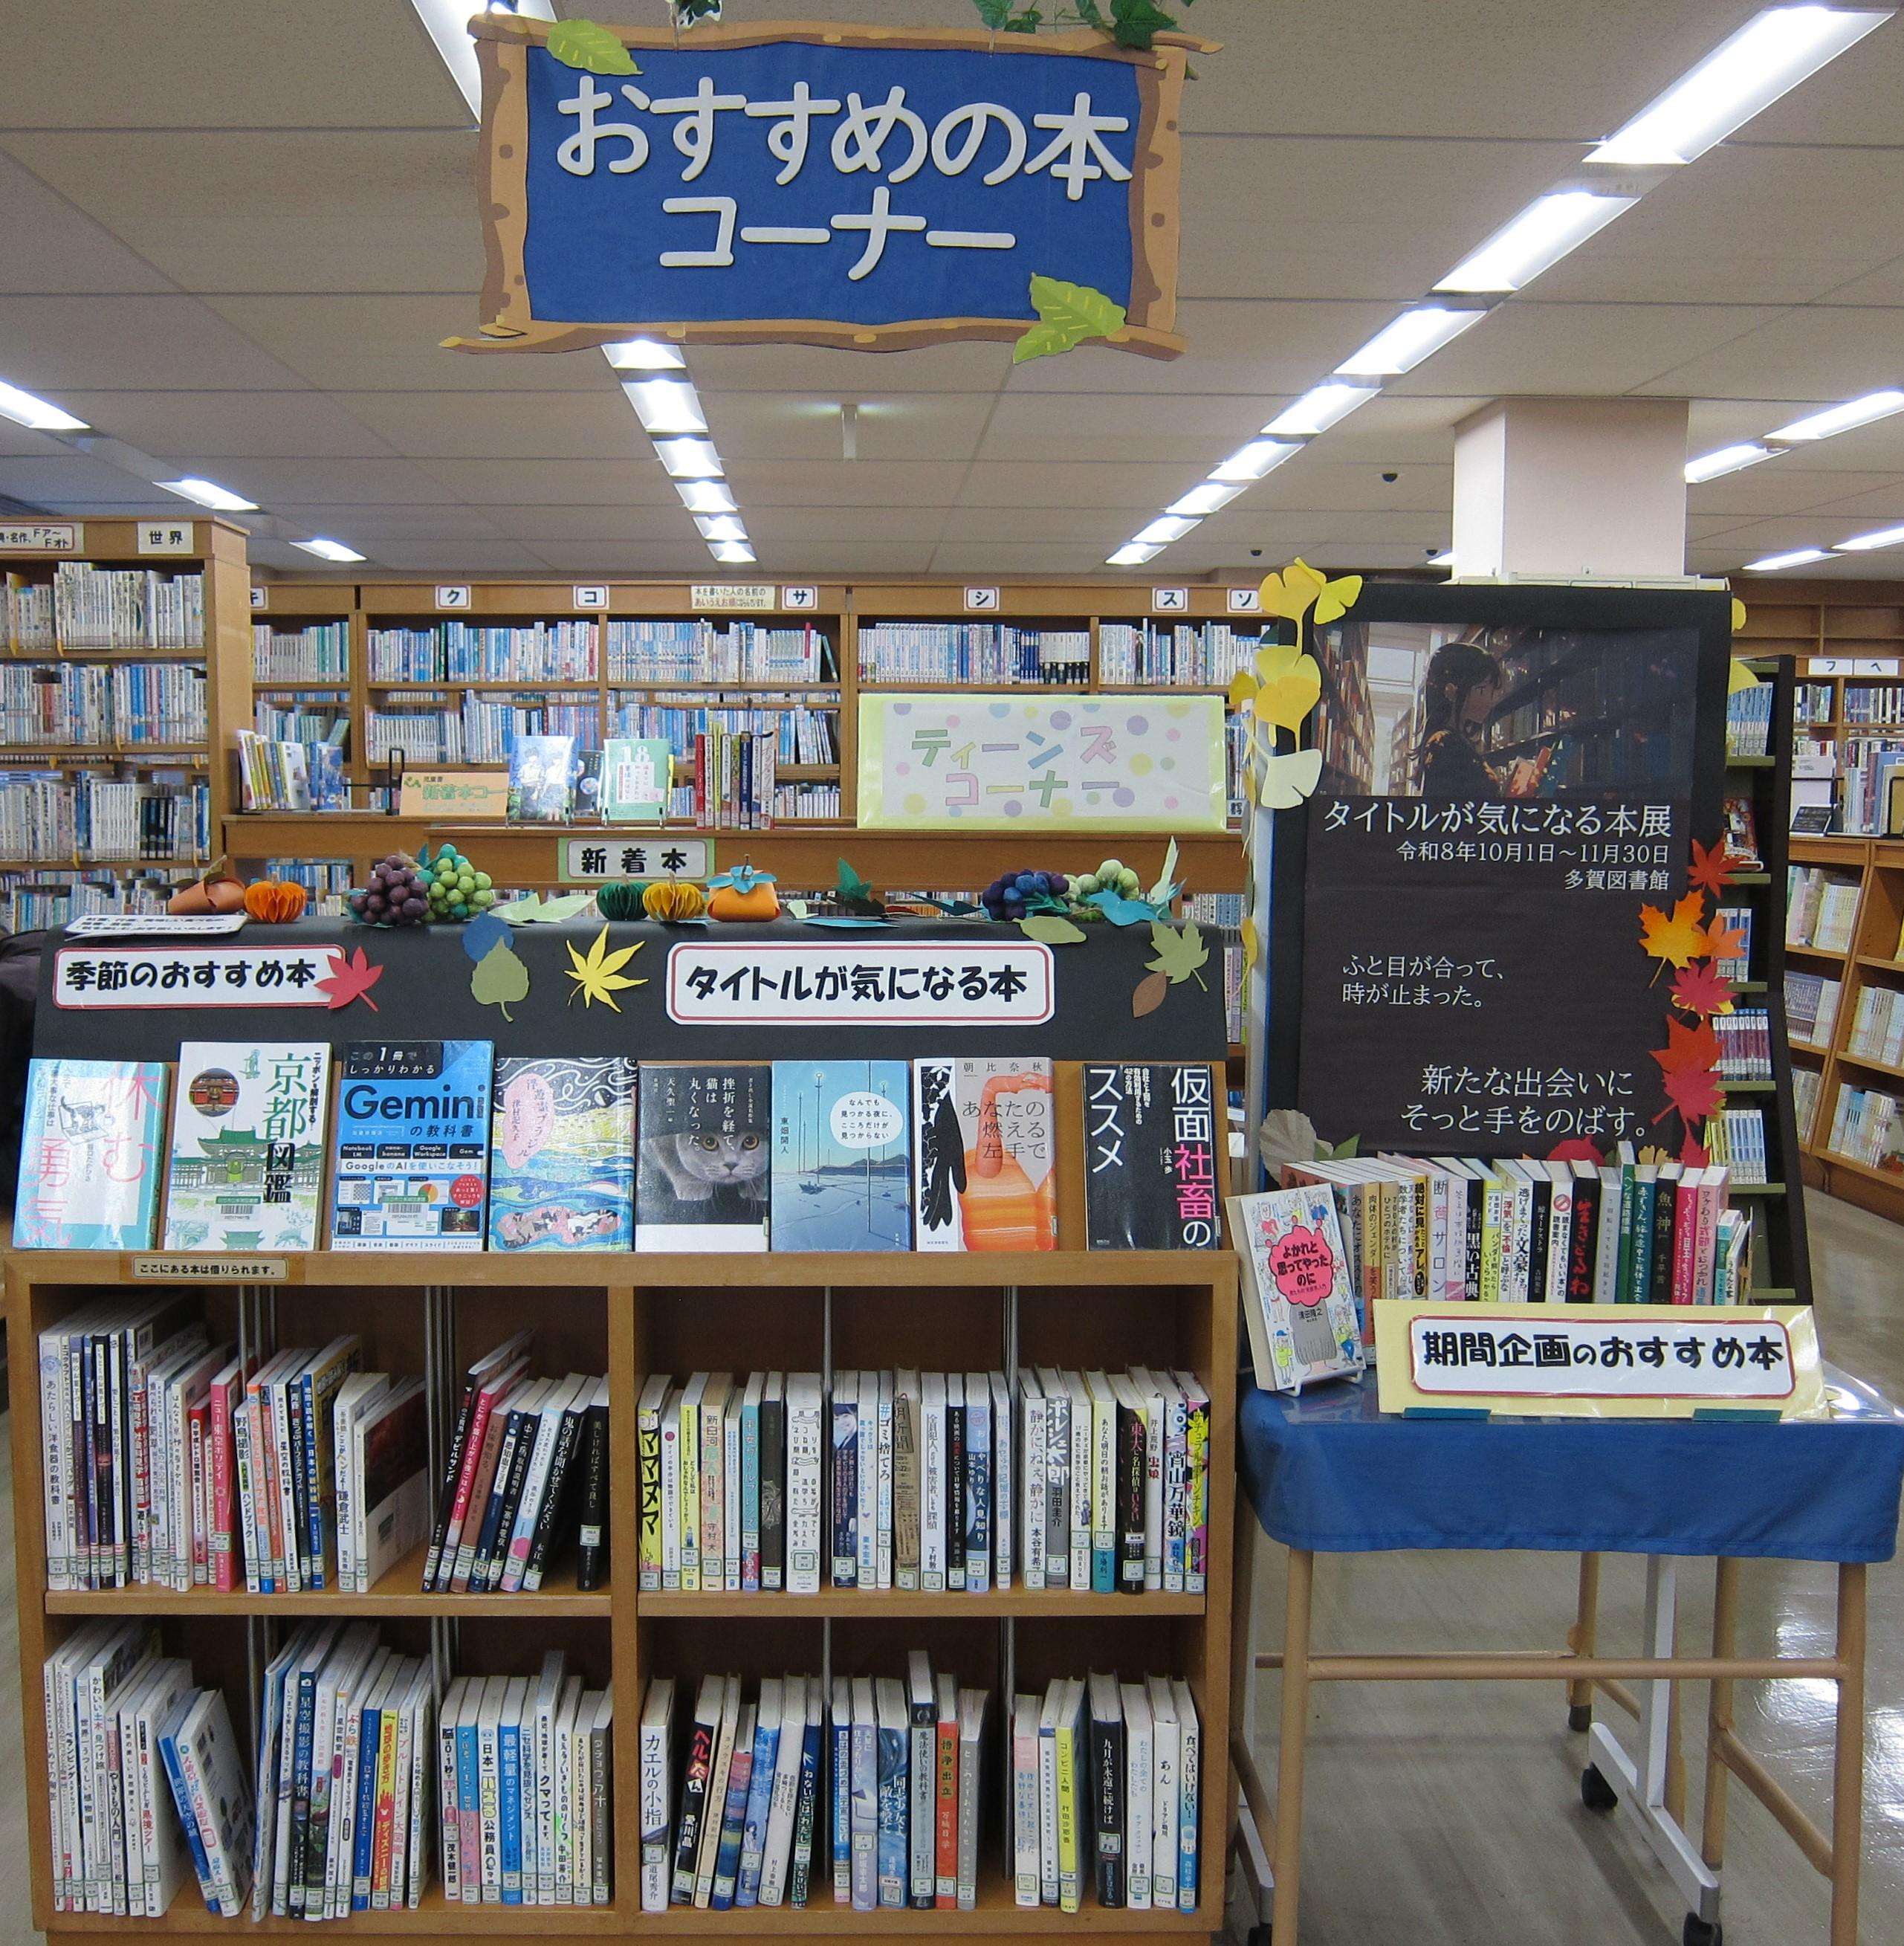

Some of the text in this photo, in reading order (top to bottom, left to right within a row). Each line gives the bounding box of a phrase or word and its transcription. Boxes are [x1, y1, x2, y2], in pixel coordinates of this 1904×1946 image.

[556, 75, 1132, 200] おすすめの本
[659, 186, 1015, 280] コーナー
[149, 531, 183, 545] 世界
[446, 589, 461, 604] ク
[584, 590, 598, 604] コ
[793, 590, 807, 605] サ
[974, 590, 989, 606] シ
[1162, 592, 1178, 606] ス
[1826, 661, 1836, 671] フ
[1871, 662, 1882, 670] ヘ
[912, 725, 1116, 769] ティーンズ
[945, 770, 1120, 808] コーナー
[1324, 801, 1672, 838] タイトルが気になる本展
[581, 848, 688, 874] 新着本
[1564, 868, 1670, 891] 多賀図書館
[66, 959, 316, 991] 季節のおすすめ本
[685, 964, 1026, 1003] タイトルが気になる本
[1342, 955, 1506, 979] ふと目が合って、
[1342, 983, 1483, 1007] 時が止まった。
[350, 1064, 435, 1074] しっかりわかる
[964, 1062, 1043, 1072] 朝比奈秋
[1421, 1064, 1633, 1096] 新たな出会いに
[344, 1084, 485, 1119] Gemini
[706, 1078, 719, 1103] 猫は
[962, 1100, 1045, 1118] あなたの
[262, 1053, 311, 1203] 京都図鑑
[410, 1125, 474, 1137] の教科書
[689, 1078, 701, 1151] 丸くなった。
[722, 1078, 736, 1151] 挫折を経て、
[982, 1122, 1045, 1138] 燃える
[1089, 1069, 1124, 1174] ススメ
[1400, 1105, 1646, 1137] そっと手をのばす。
[780, 1117, 789, 1154] 東畑開人
[982, 1142, 1045, 1160] 左手で
[346, 1161, 477, 1171] GoogleのAIを使いこなそう!
[1171, 1067, 1213, 1247] 仮面社畜の
[1552, 1216, 1560, 1245] 読書案内
[1278, 1255, 1329, 1276] 思ってやった
[1283, 1242, 1318, 1258] よかれと
[1466, 1233, 1480, 1298] 黒い古典
[1558, 1213, 1570, 1296] 「読まなくてもいい本」の
[140, 1263, 276, 1276] ここにある本は借りられます。
[1298, 1273, 1315, 1286] のに
[1421, 1331, 1784, 1371] 期間企画のおすすめ本
[46, 1380, 60, 1504] あたらしい洋食器の教科書
[213, 1400, 222, 1480] ニュー東京ホリデイ
[540, 1417, 574, 1530] 鬼の話を聞かせてください
[744, 1420, 758, 1529] 平安ガールフレンズ
[977, 1429, 986, 1542] おしゃべりな人見知り
[1193, 1413, 1202, 1527] ナチュラルボーンチキン
[1052, 1487, 1062, 1527] 羽田圭介
[1168, 1451, 1186, 1537] 宵山万華鏡
[1031, 1528, 1042, 1571] 本谷有希
[92, 1677, 104, 1730] かわいい土木
[297, 1696, 313, 1797] 星空撮影の教科書
[644, 1734, 662, 1826] カエルの小指
[919, 1731, 929, 1803] 魔法使いの教科書
[941, 1739, 953, 1798] 悟浄出立
[1061, 1742, 1070, 1794] コンビニ人間
[1102, 1739, 1113, 1825] 九月が永遠に続けば
[1160, 1760, 1171, 1785] あん
[503, 1734, 518, 1841] 最軽量のマネジメント
[110, 1774, 121, 1840] やきもの入門
[800, 1817, 809, 1843] わたし
[447, 1844, 456, 1883] 茂木健一郎
[648, 1866, 658, 1900] 道尾秀介
